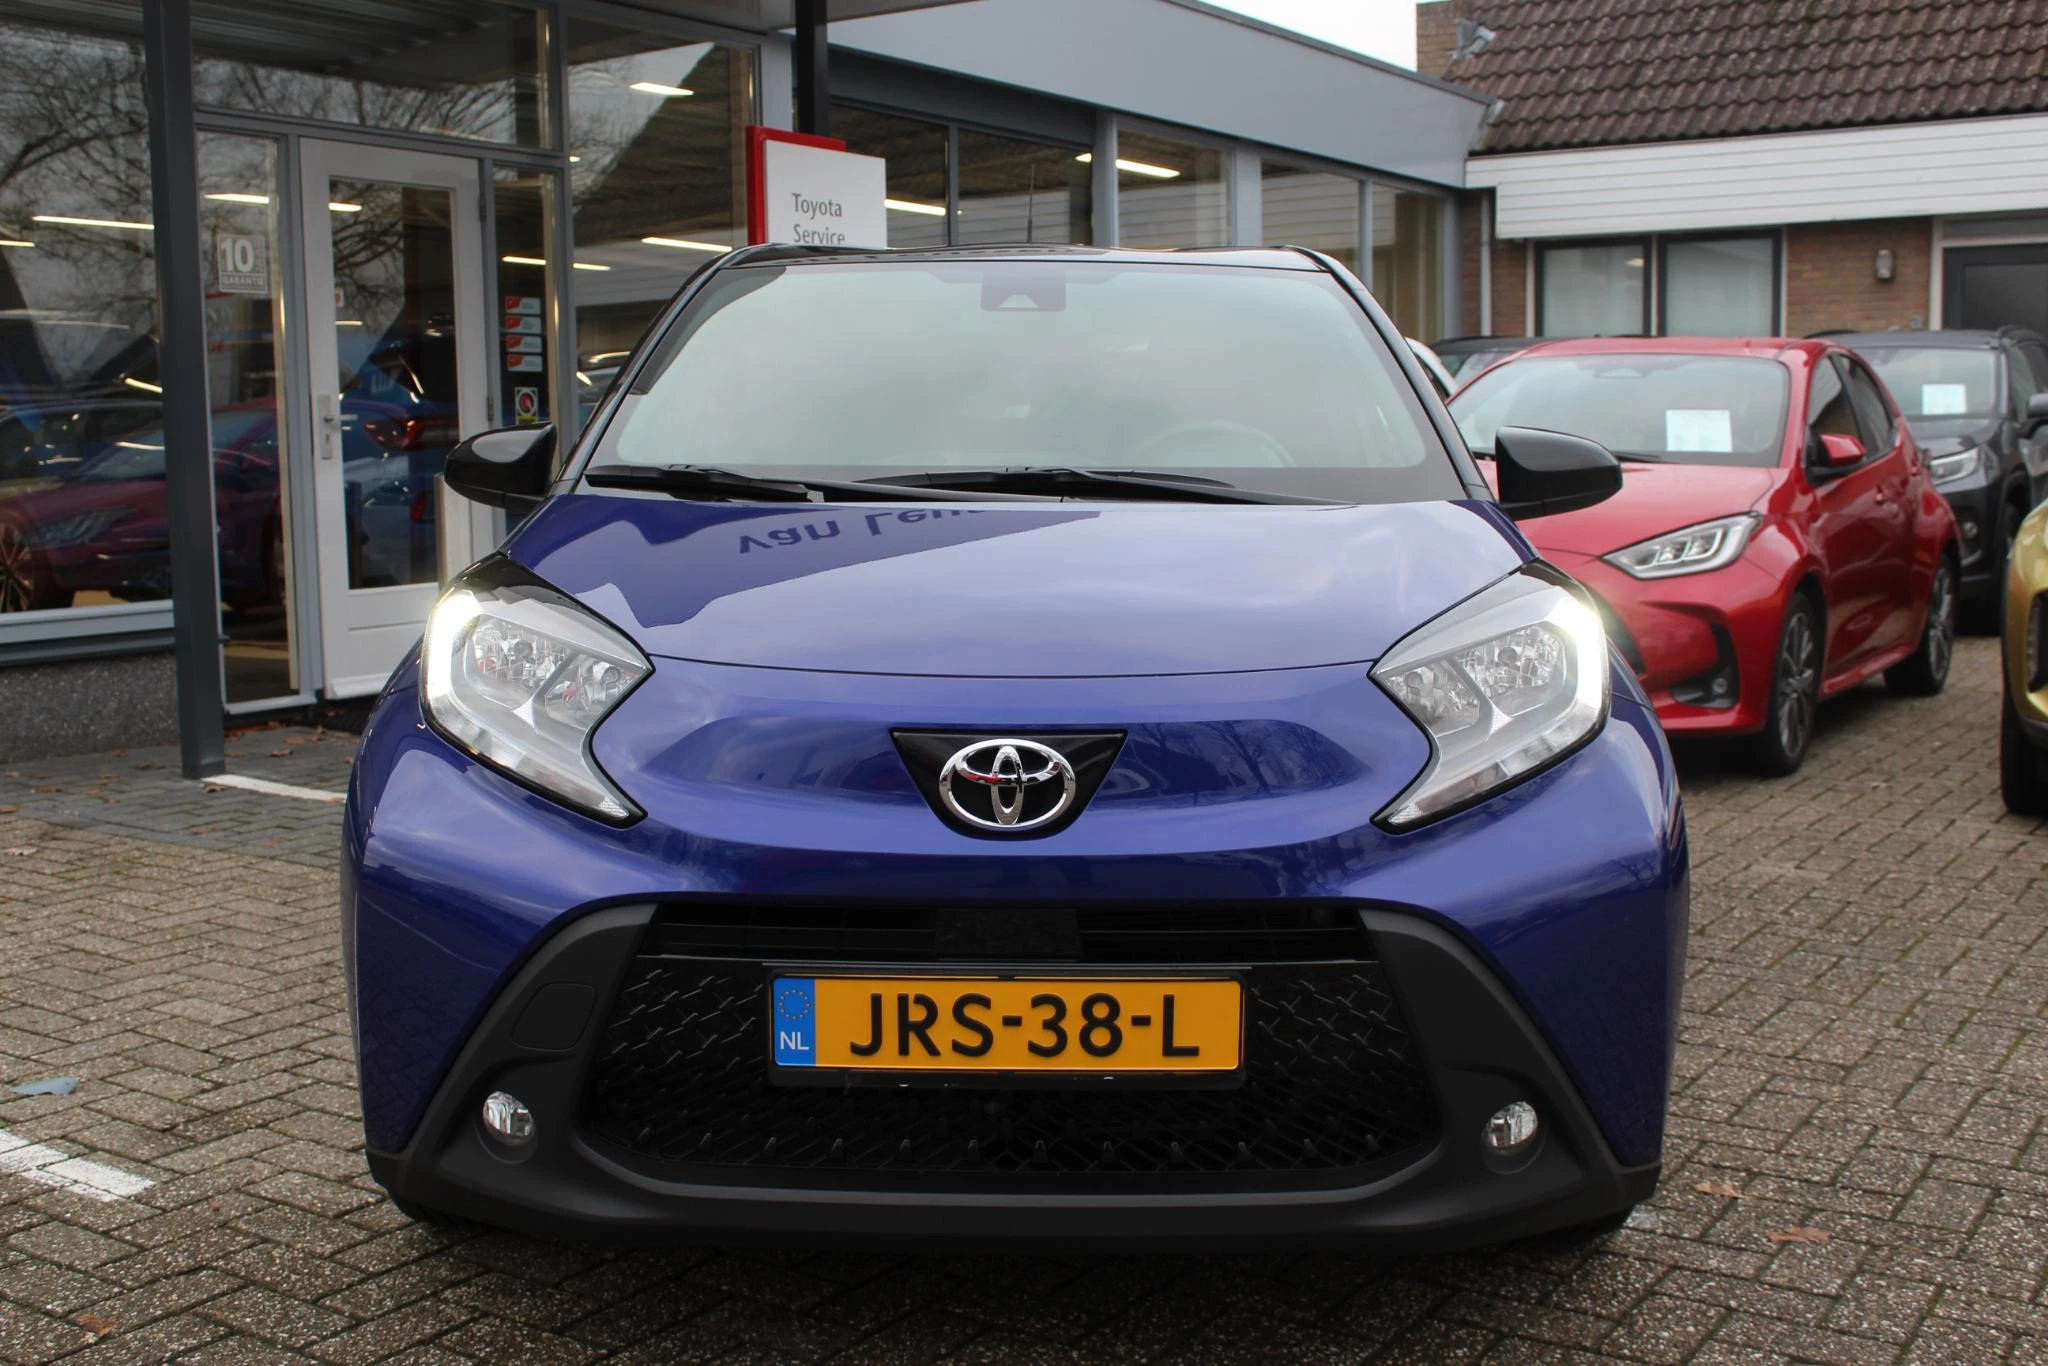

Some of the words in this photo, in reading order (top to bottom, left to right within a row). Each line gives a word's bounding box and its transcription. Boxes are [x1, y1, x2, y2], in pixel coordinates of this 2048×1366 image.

[792, 193, 842, 220] Toyota
[794, 224, 845, 245] Service
[221, 238, 254, 273] 10
[850, 993, 1200, 1058] JRS-38-L
[780, 1032, 810, 1051] NL
